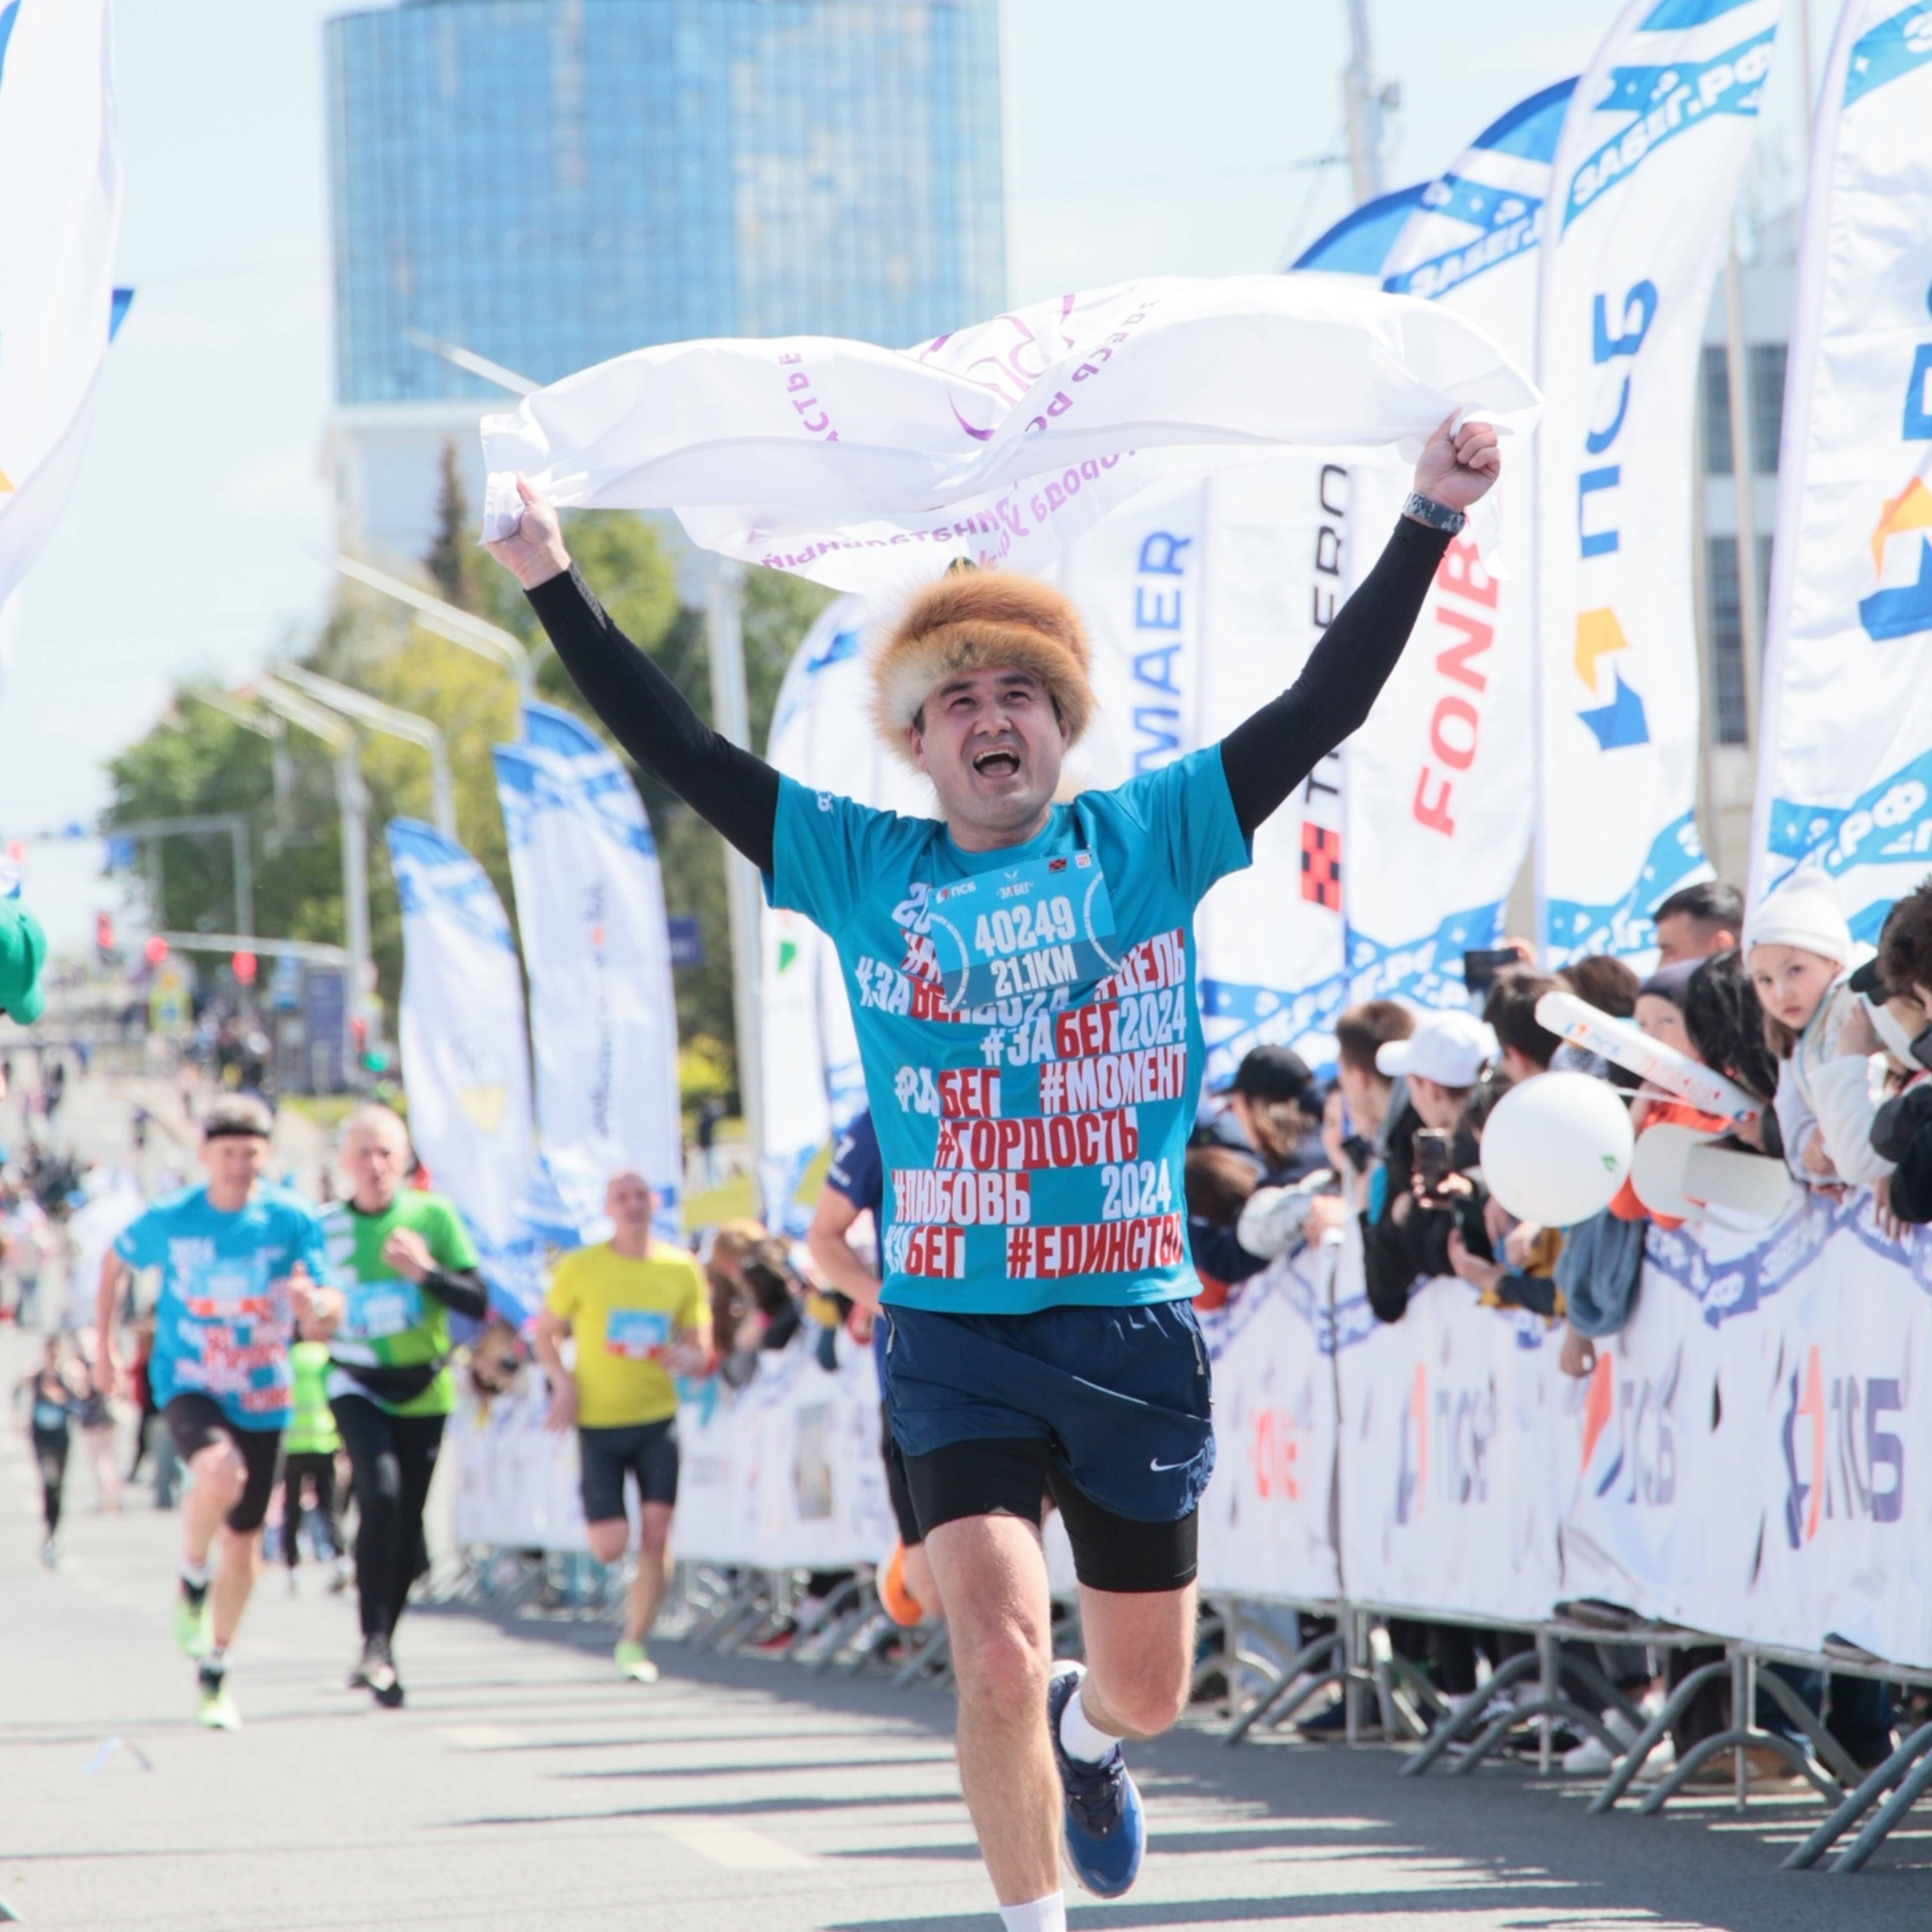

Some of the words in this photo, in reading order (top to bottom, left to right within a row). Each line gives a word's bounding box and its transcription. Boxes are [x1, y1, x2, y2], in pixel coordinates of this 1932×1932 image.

[951, 881, 977, 898] ПСБ
[974, 896, 1076, 958] 40249
[980, 985, 1186, 1067] #ЗАБЕГ2024
[1039, 1043, 1187, 1115] #МОМЕНТ
[933, 1107, 1138, 1171] #ГОРДОСТЬ
[891, 1170, 1031, 1225] #ЛЮБОВЬ
[1101, 1158, 1171, 1221] 2024
[1006, 1211, 1184, 1279] #ЕДИНСТВО
